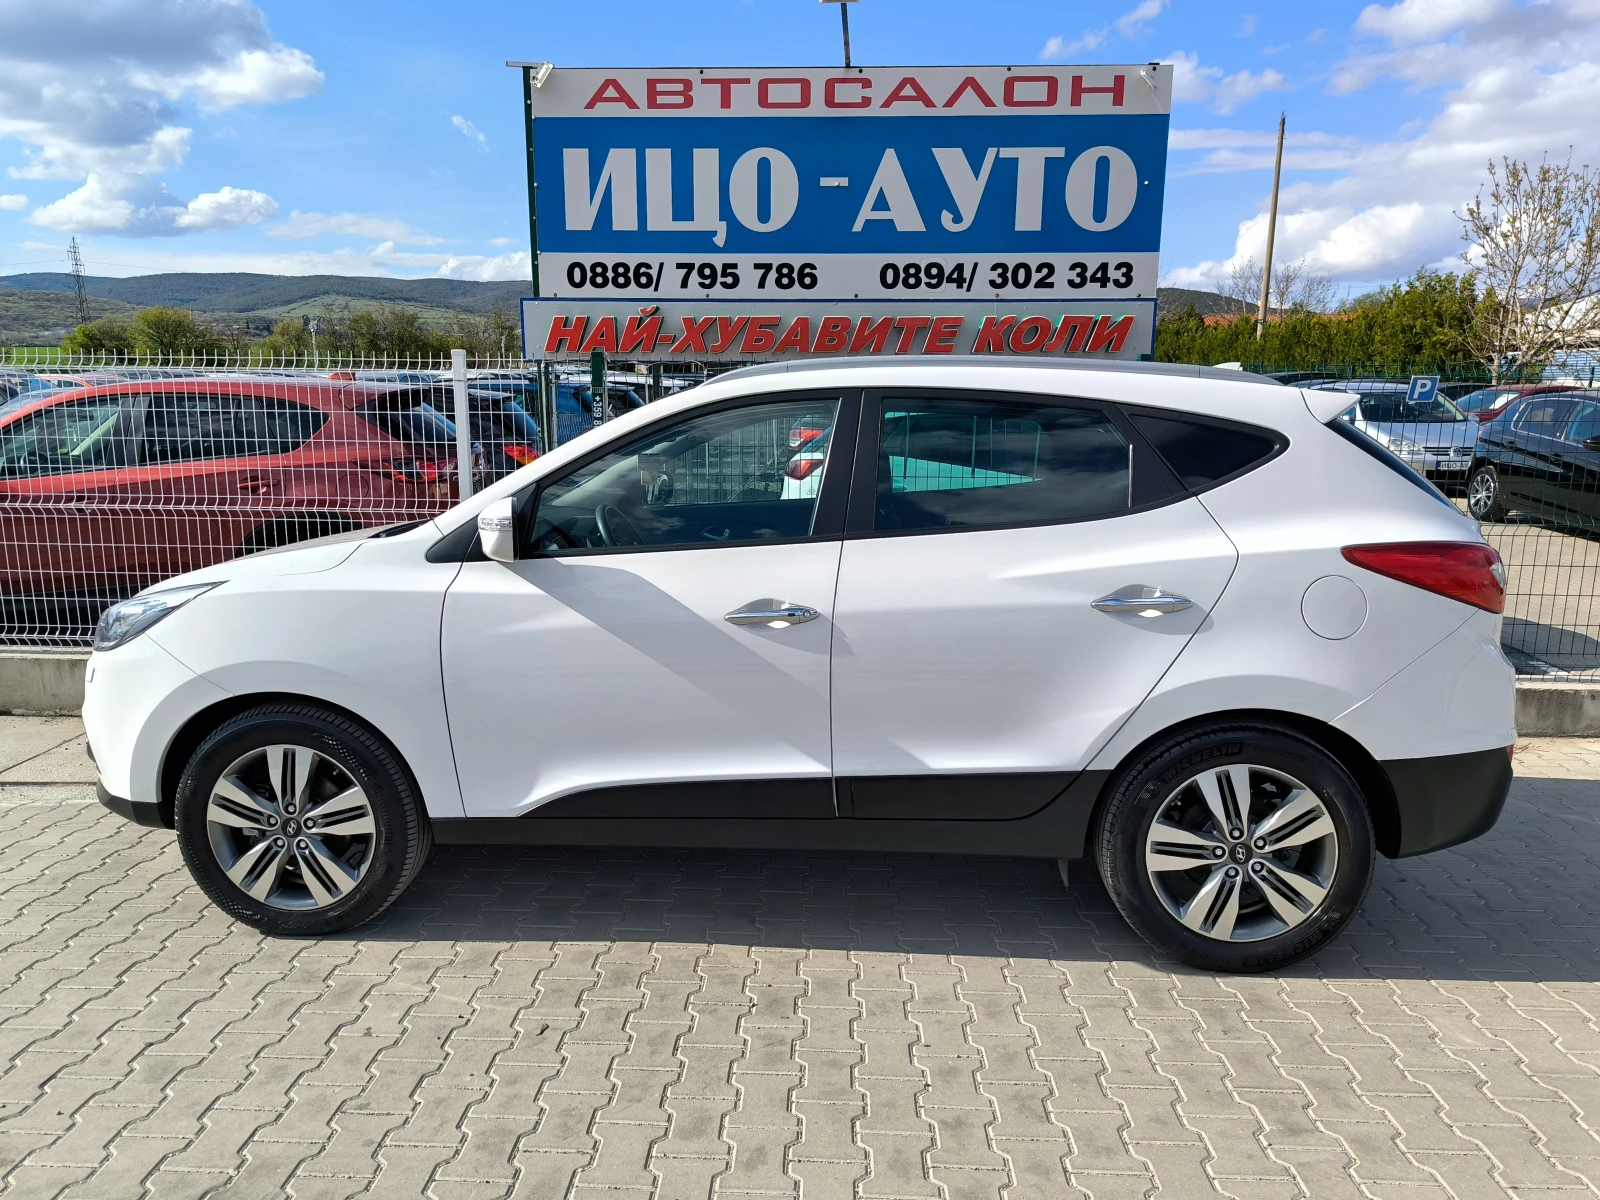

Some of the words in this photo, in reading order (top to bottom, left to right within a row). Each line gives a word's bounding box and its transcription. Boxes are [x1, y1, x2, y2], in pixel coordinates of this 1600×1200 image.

[583, 75, 1126, 110] АВТОСАЛОН
[566, 261, 664, 292] 0886/
[675, 262, 740, 290] 795
[753, 262, 818, 290] 786
[879, 261, 979, 292] 0894/
[988, 261, 1055, 290] 302
[1067, 261, 1134, 290] 343
[544, 304, 964, 354] НАЙ-ХУБАВИТЕ
[971, 314, 1136, 354] КОЛИ
[1413, 379, 1432, 399] P
[593, 395, 603, 418] +359
[1161, 743, 1241, 781] MICHELIN
